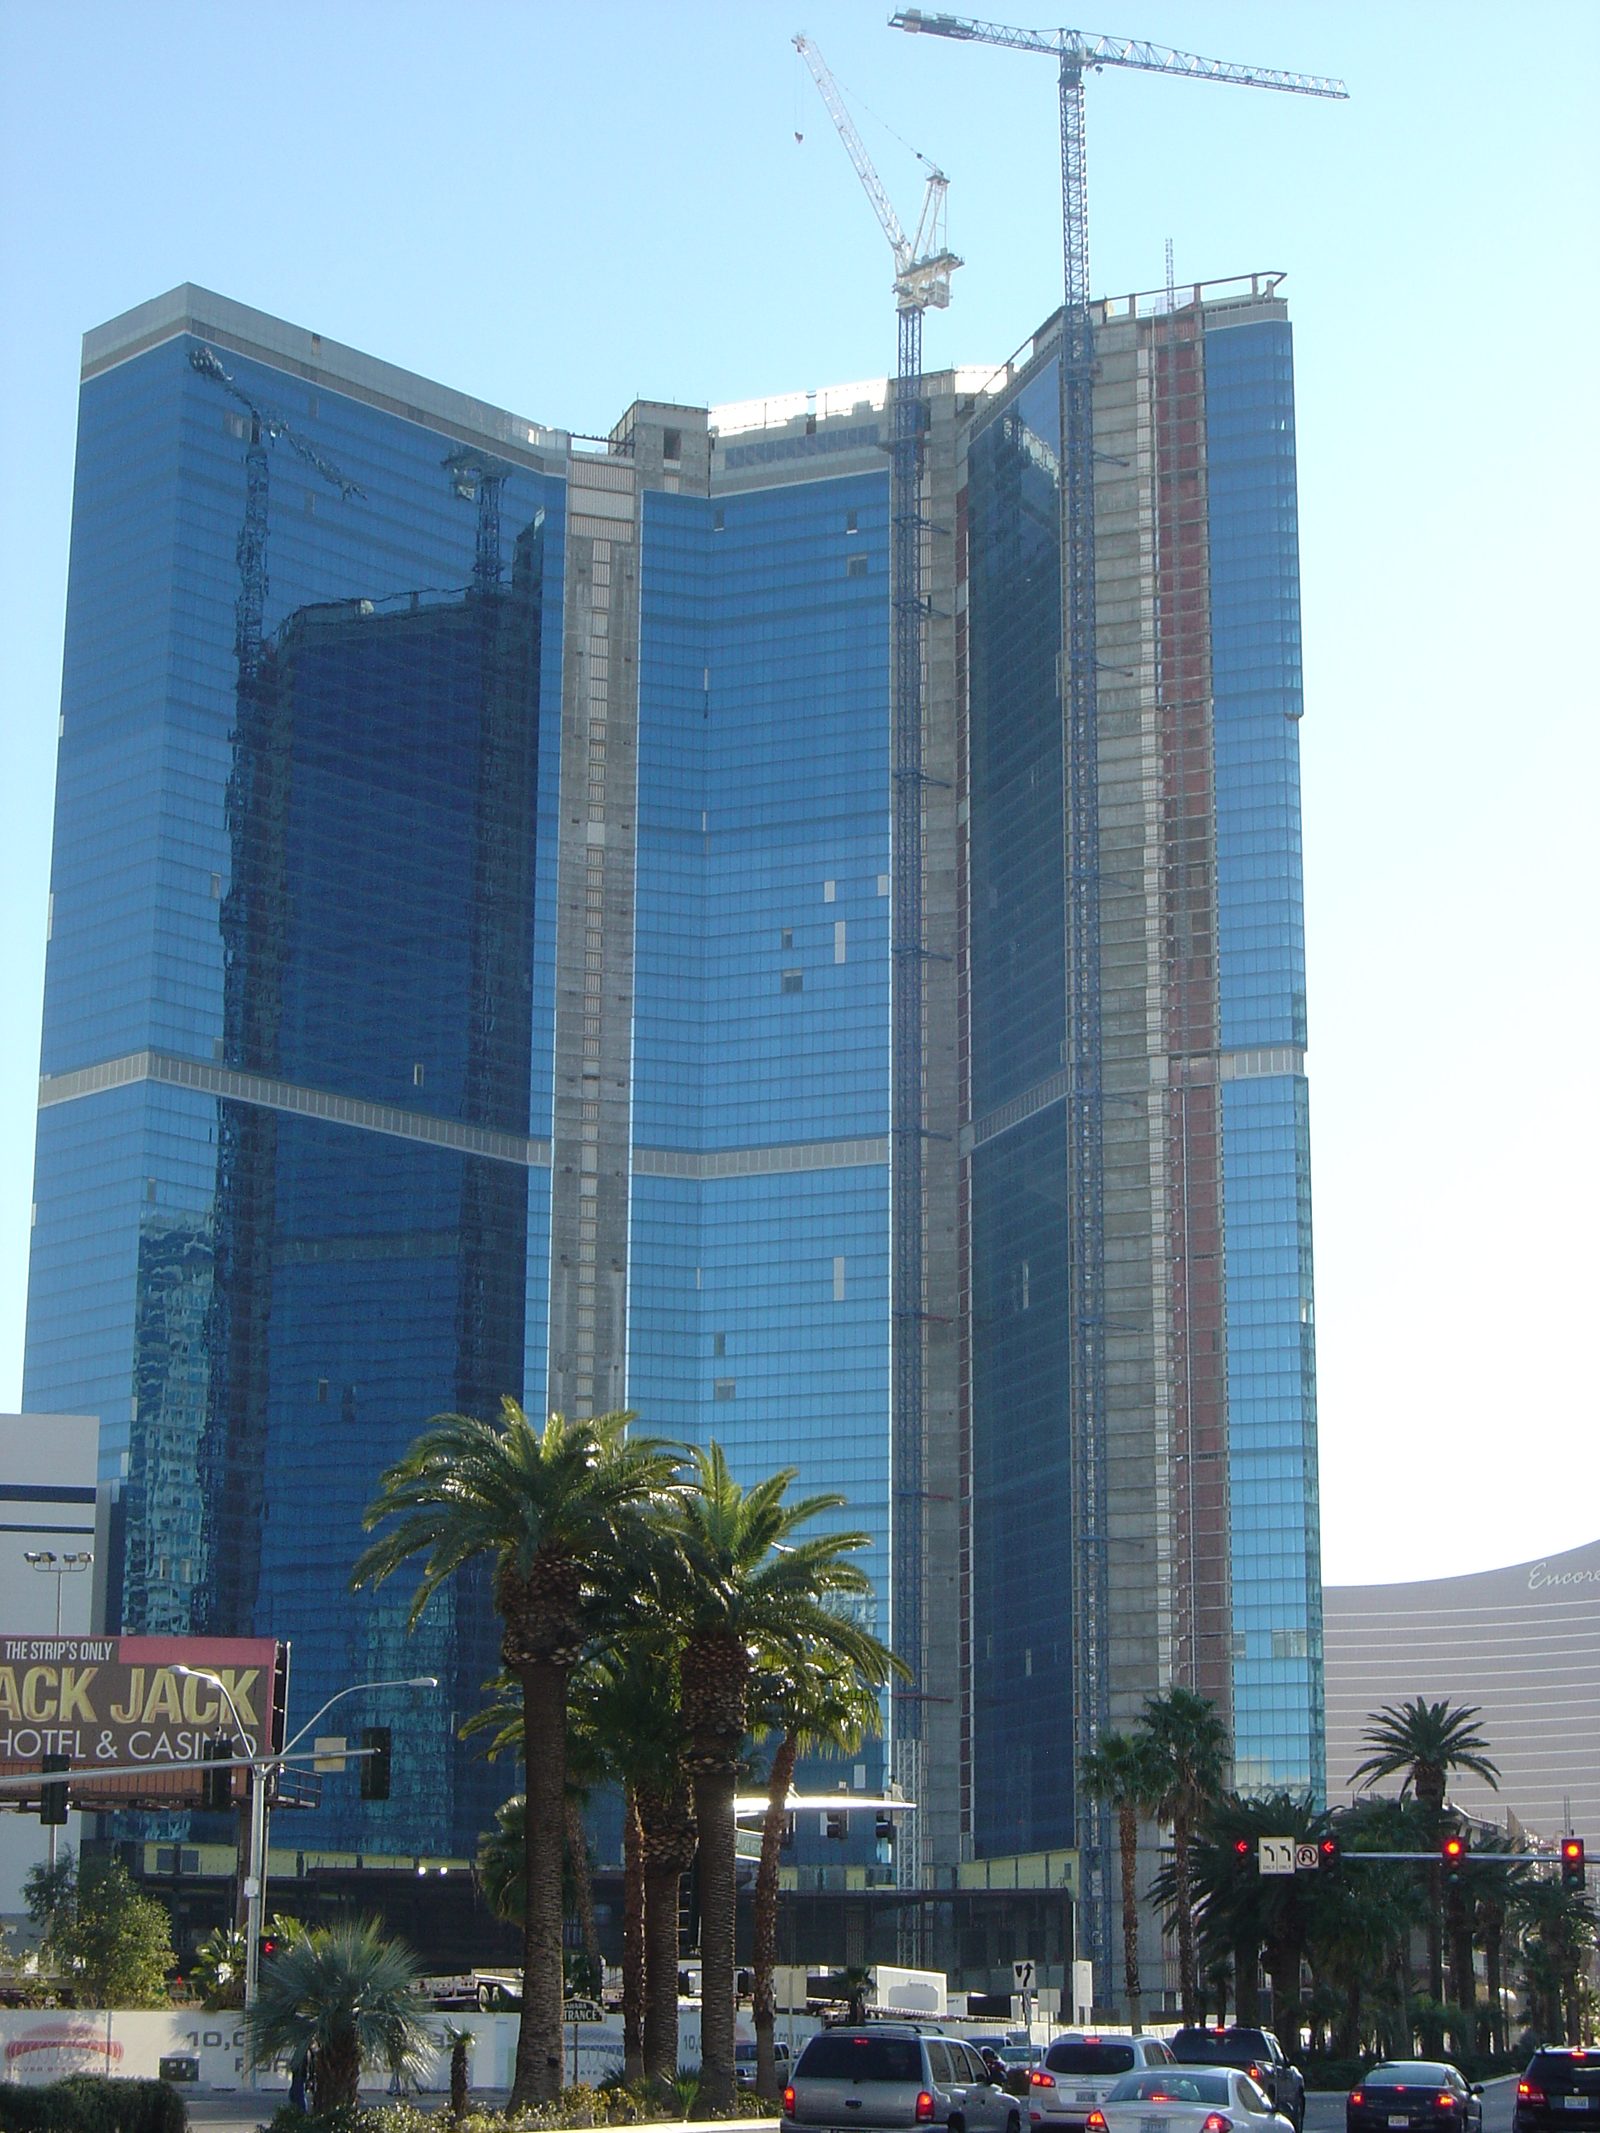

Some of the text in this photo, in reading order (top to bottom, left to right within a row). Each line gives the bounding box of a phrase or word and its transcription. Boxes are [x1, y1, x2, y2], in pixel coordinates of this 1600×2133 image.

[1527, 1561, 1600, 1589] Encore
[5, 1640, 112, 1660] THE STRIP'S ONLY
[110, 1667, 260, 1725] JACK
[0, 1728, 86, 1758] HOTEL
[96, 1730, 117, 1758] &
